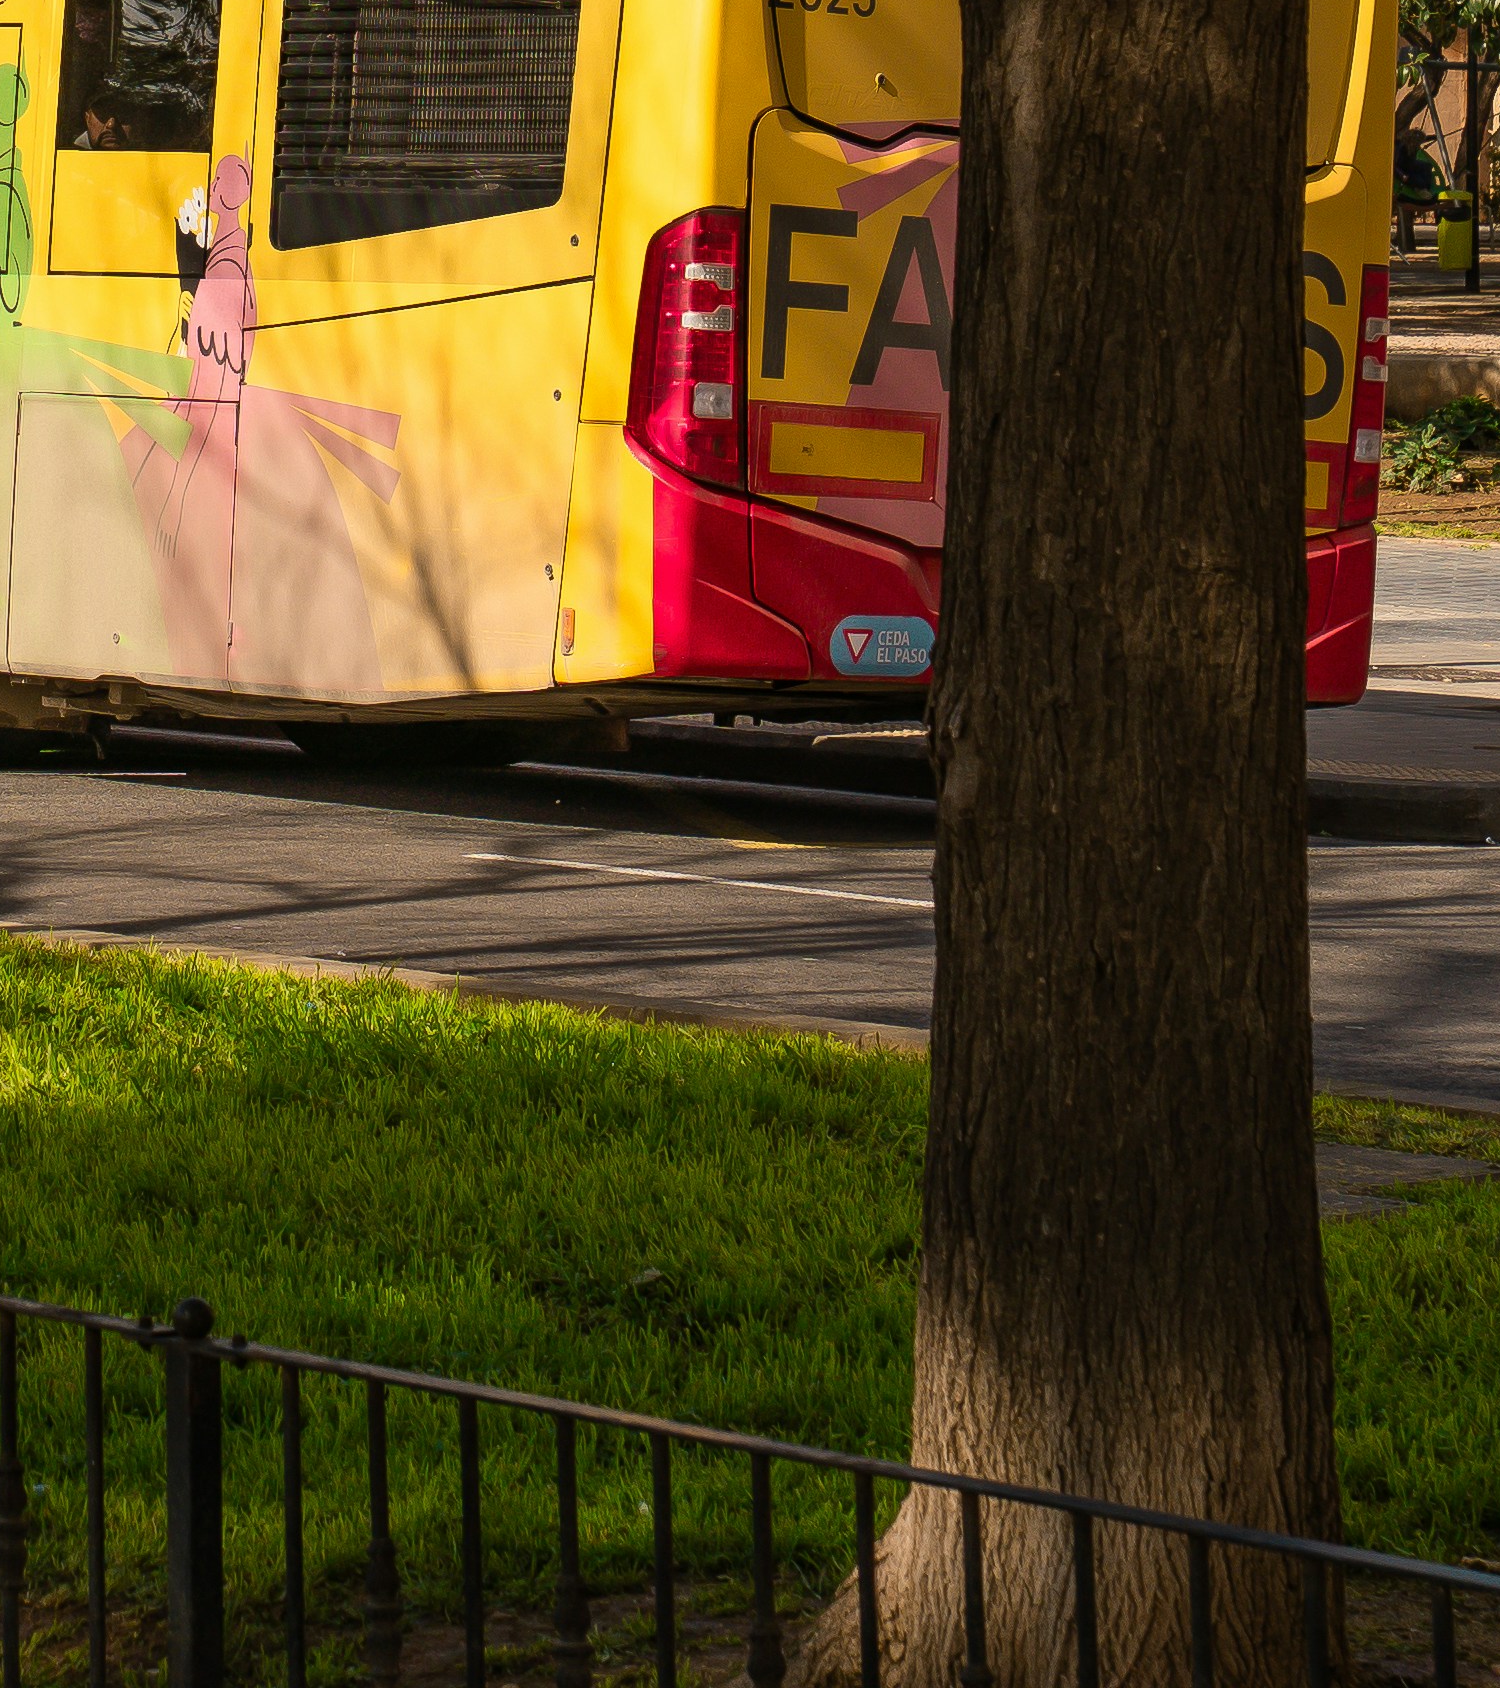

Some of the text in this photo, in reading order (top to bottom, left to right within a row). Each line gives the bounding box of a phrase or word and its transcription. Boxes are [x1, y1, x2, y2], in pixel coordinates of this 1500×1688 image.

[877, 630, 910, 646] CEDA
[877, 648, 927, 664] EL PASO
